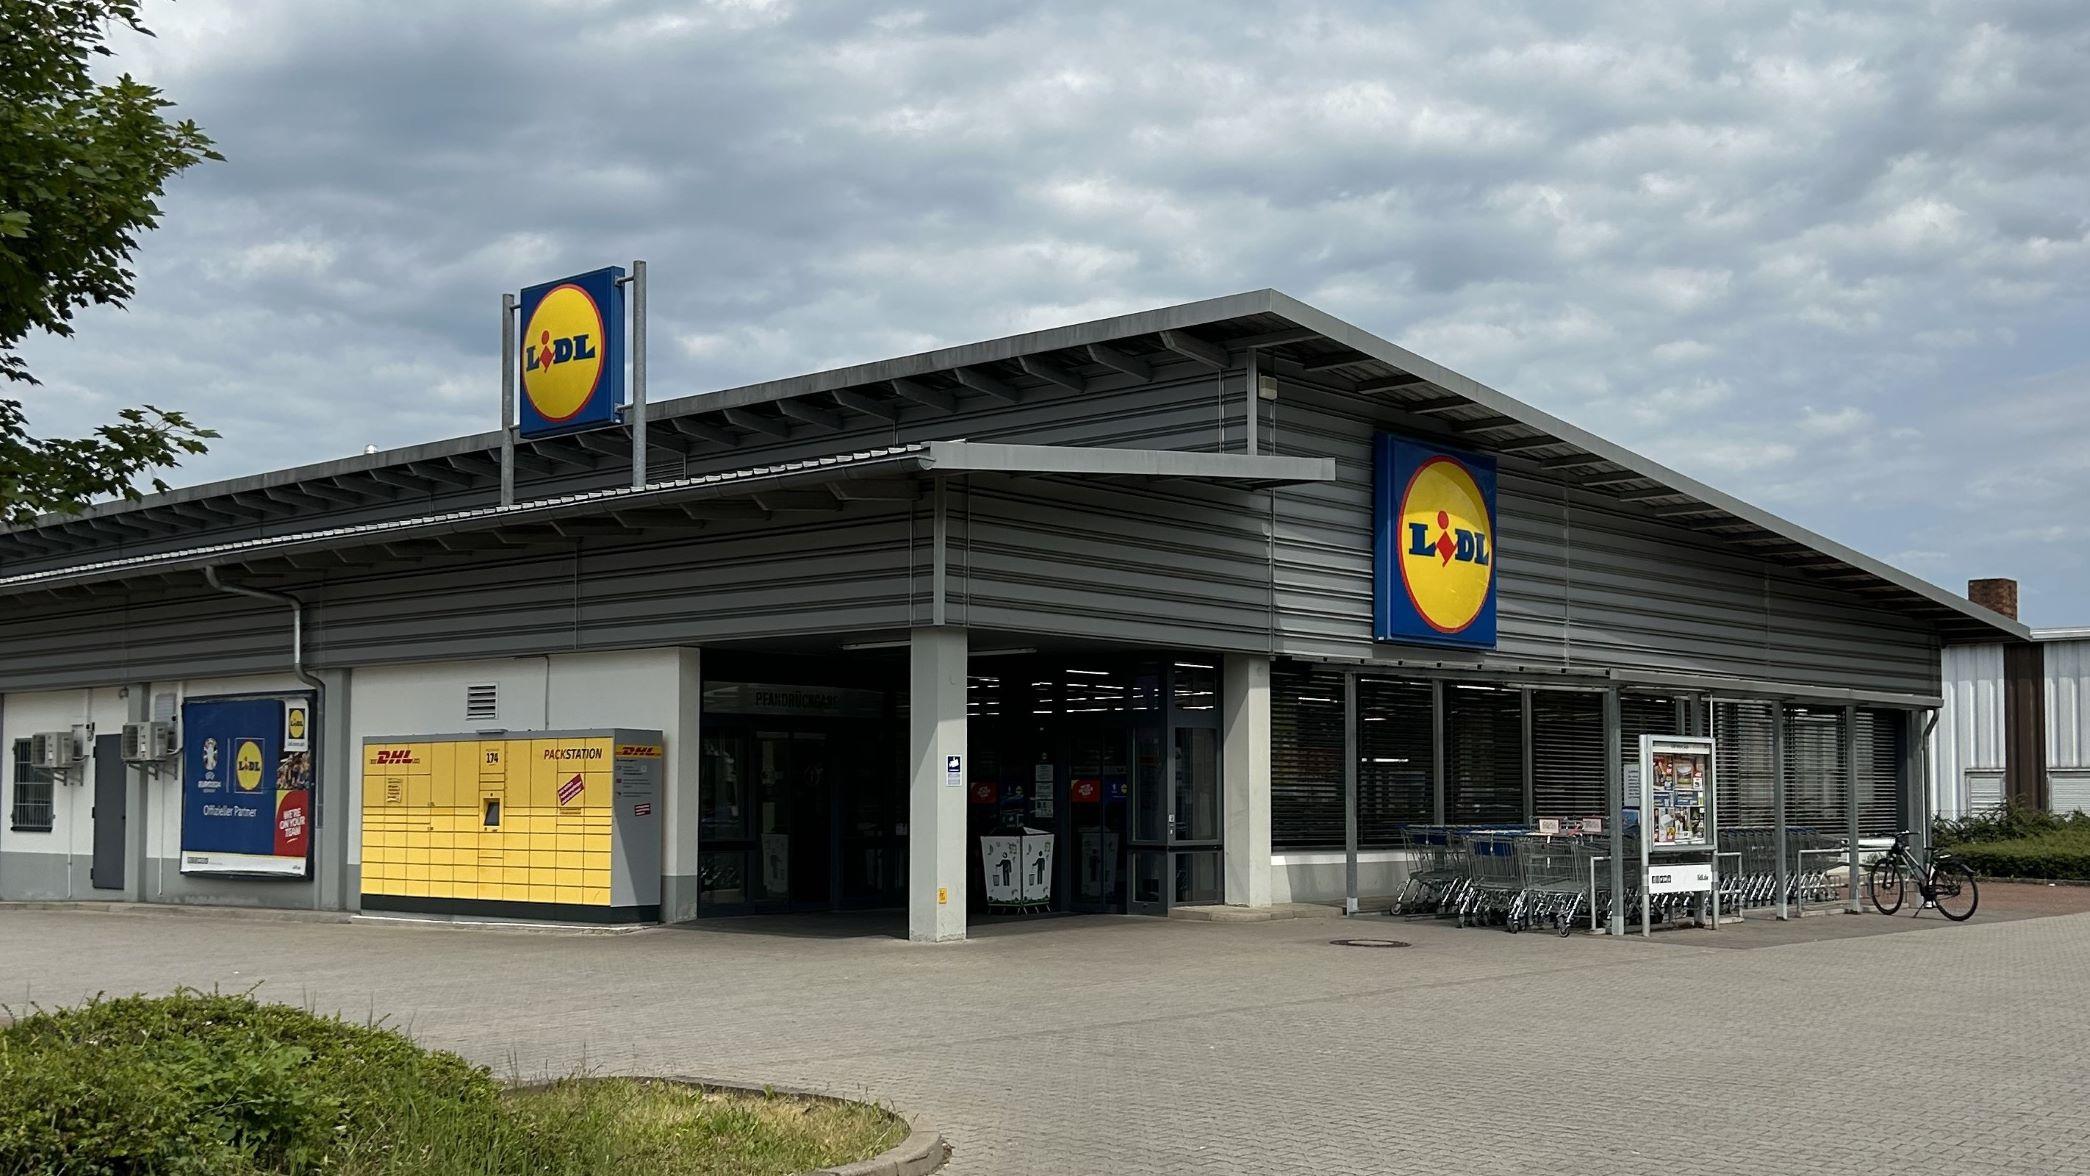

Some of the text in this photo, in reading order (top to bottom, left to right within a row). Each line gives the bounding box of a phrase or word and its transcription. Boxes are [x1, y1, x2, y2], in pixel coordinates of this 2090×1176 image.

[526, 330, 596, 374] LIDL
[1408, 510, 1490, 568] LIDL
[377, 750, 413, 764] DHL
[486, 752, 499, 763] 174
[543, 748, 603, 760] PACKSTATION
[622, 746, 656, 756] DHL
[238, 756, 261, 771] LIDL
[203, 805, 257, 817] Offizieller Partner
[279, 815, 306, 830] ON YOUR
[285, 826, 301, 838] TEAM
